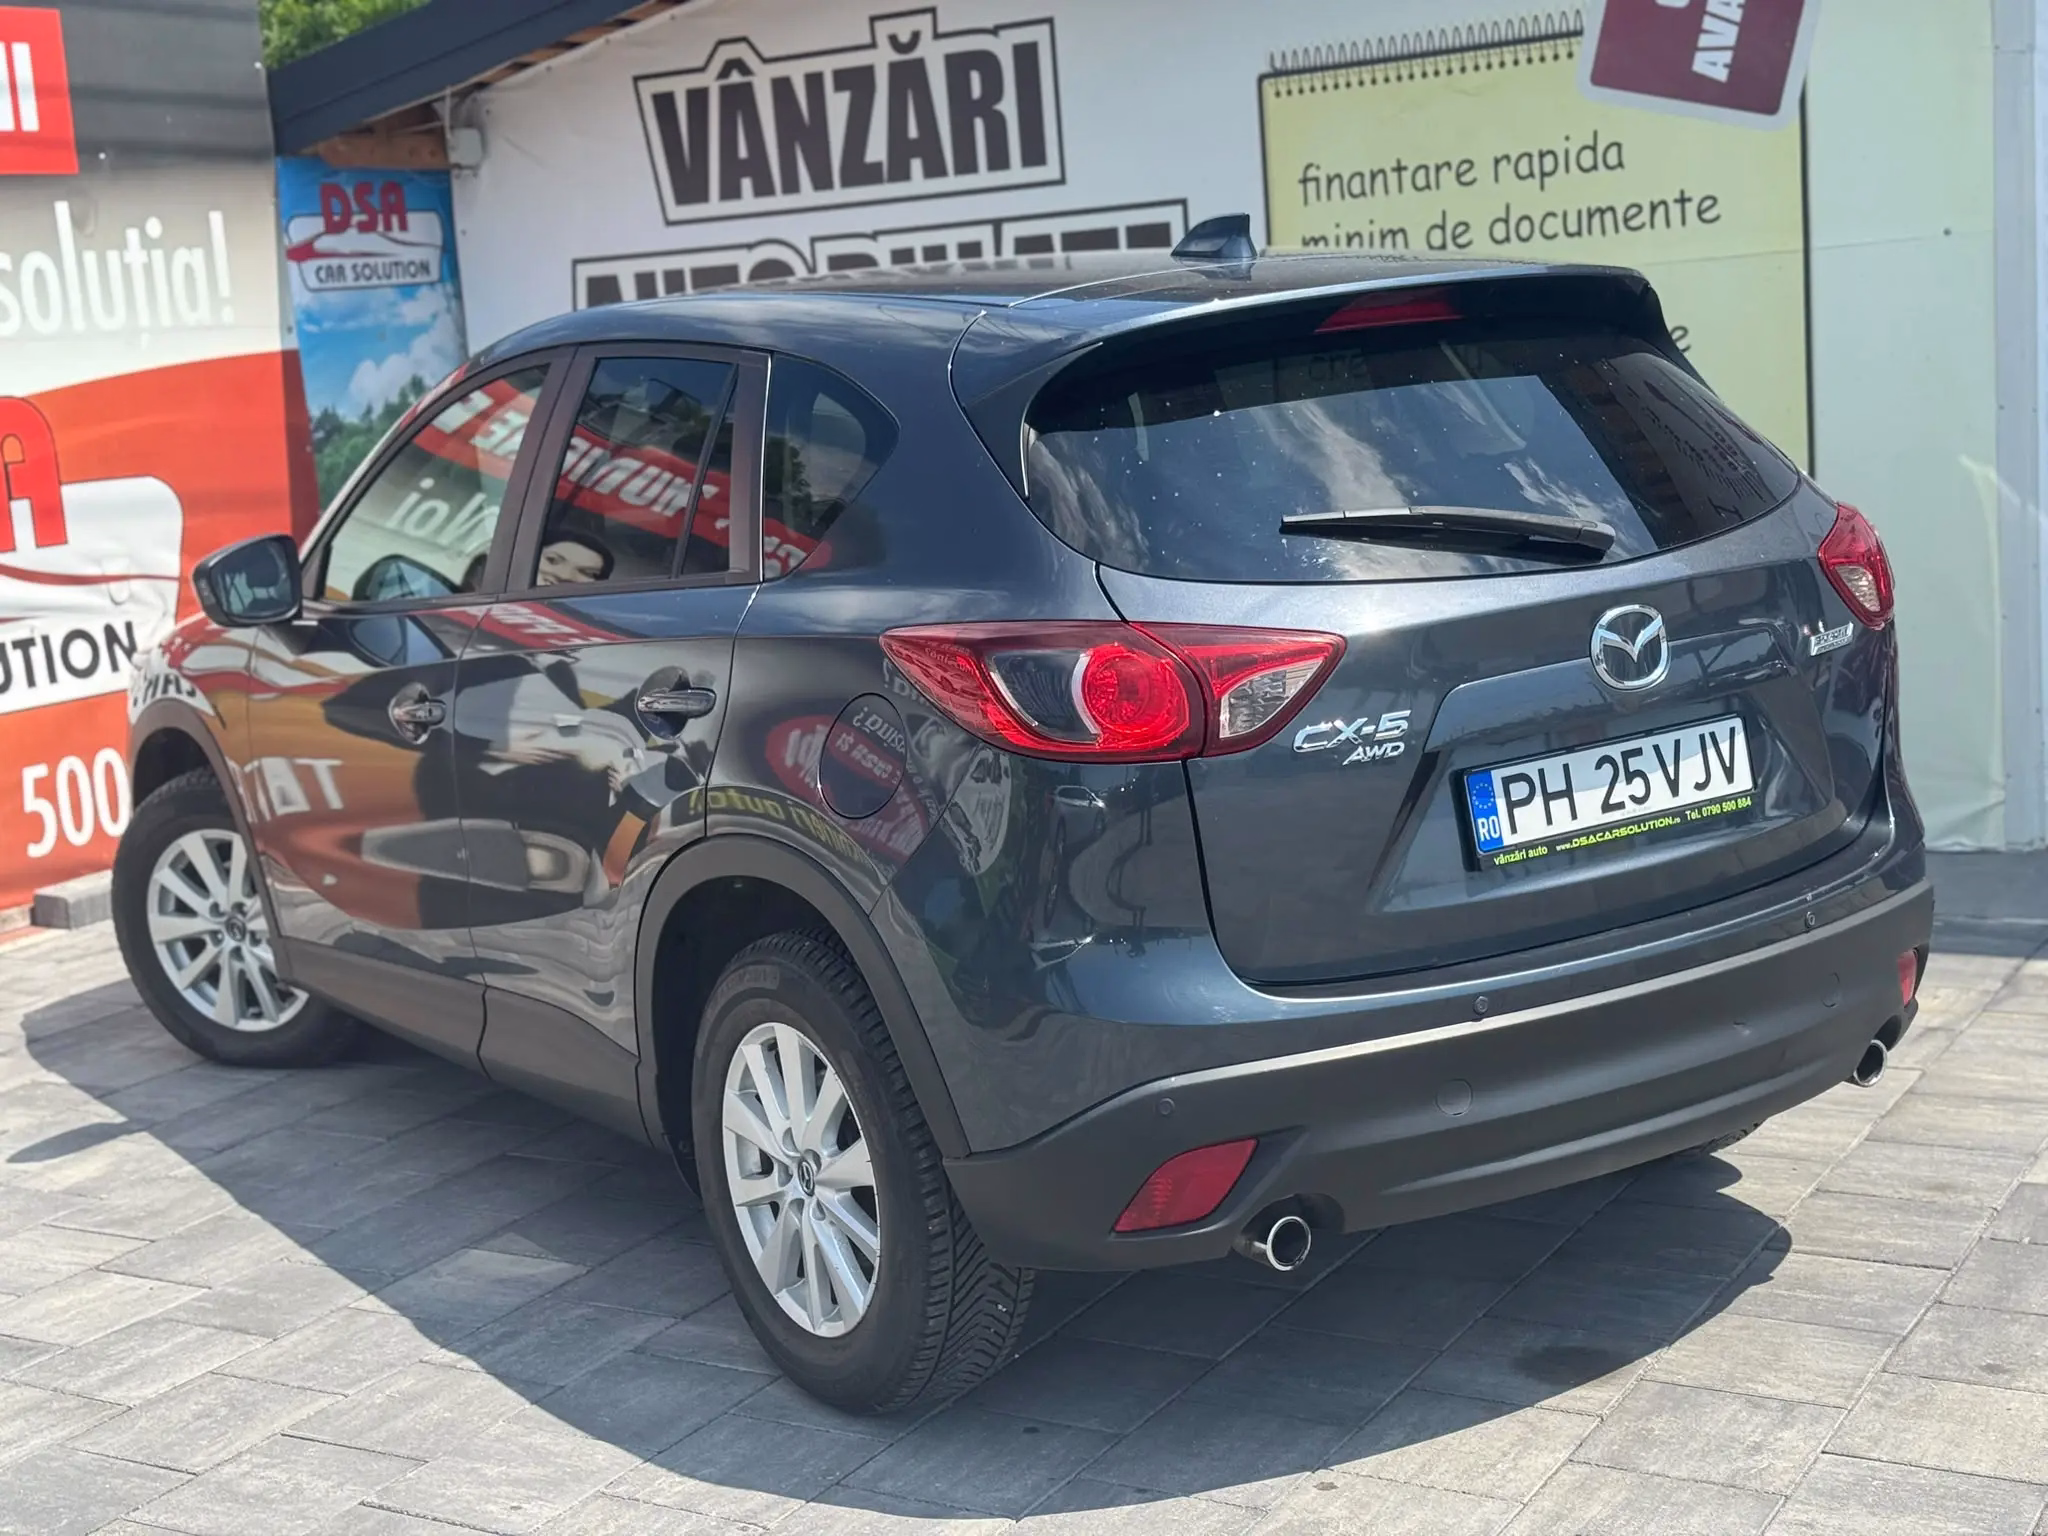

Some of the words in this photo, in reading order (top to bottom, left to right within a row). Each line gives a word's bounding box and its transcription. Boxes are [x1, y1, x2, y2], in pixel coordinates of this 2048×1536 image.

[650, 30, 1048, 206] VÂNZĂRI
[1298, 157, 1478, 206] finantare
[1493, 130, 1625, 191] rapida
[320, 180, 409, 235] DSA
[1425, 209, 1474, 251] de
[1488, 189, 1721, 245] documente
[314, 263, 347, 284] CAR
[351, 258, 431, 283] SOLUTION
[1292, 709, 1412, 753] CX-5
[1341, 741, 1406, 766] AWD
[21, 747, 132, 859] 500
[1501, 763, 1578, 835] PH
[1594, 746, 1651, 815] 25
[1652, 726, 1736, 798] VJV
[1477, 815, 1500, 842] RO
[1528, 845, 1549, 859] auto
[1702, 803, 1722, 818] 0790
[1722, 799, 1736, 813] 500
